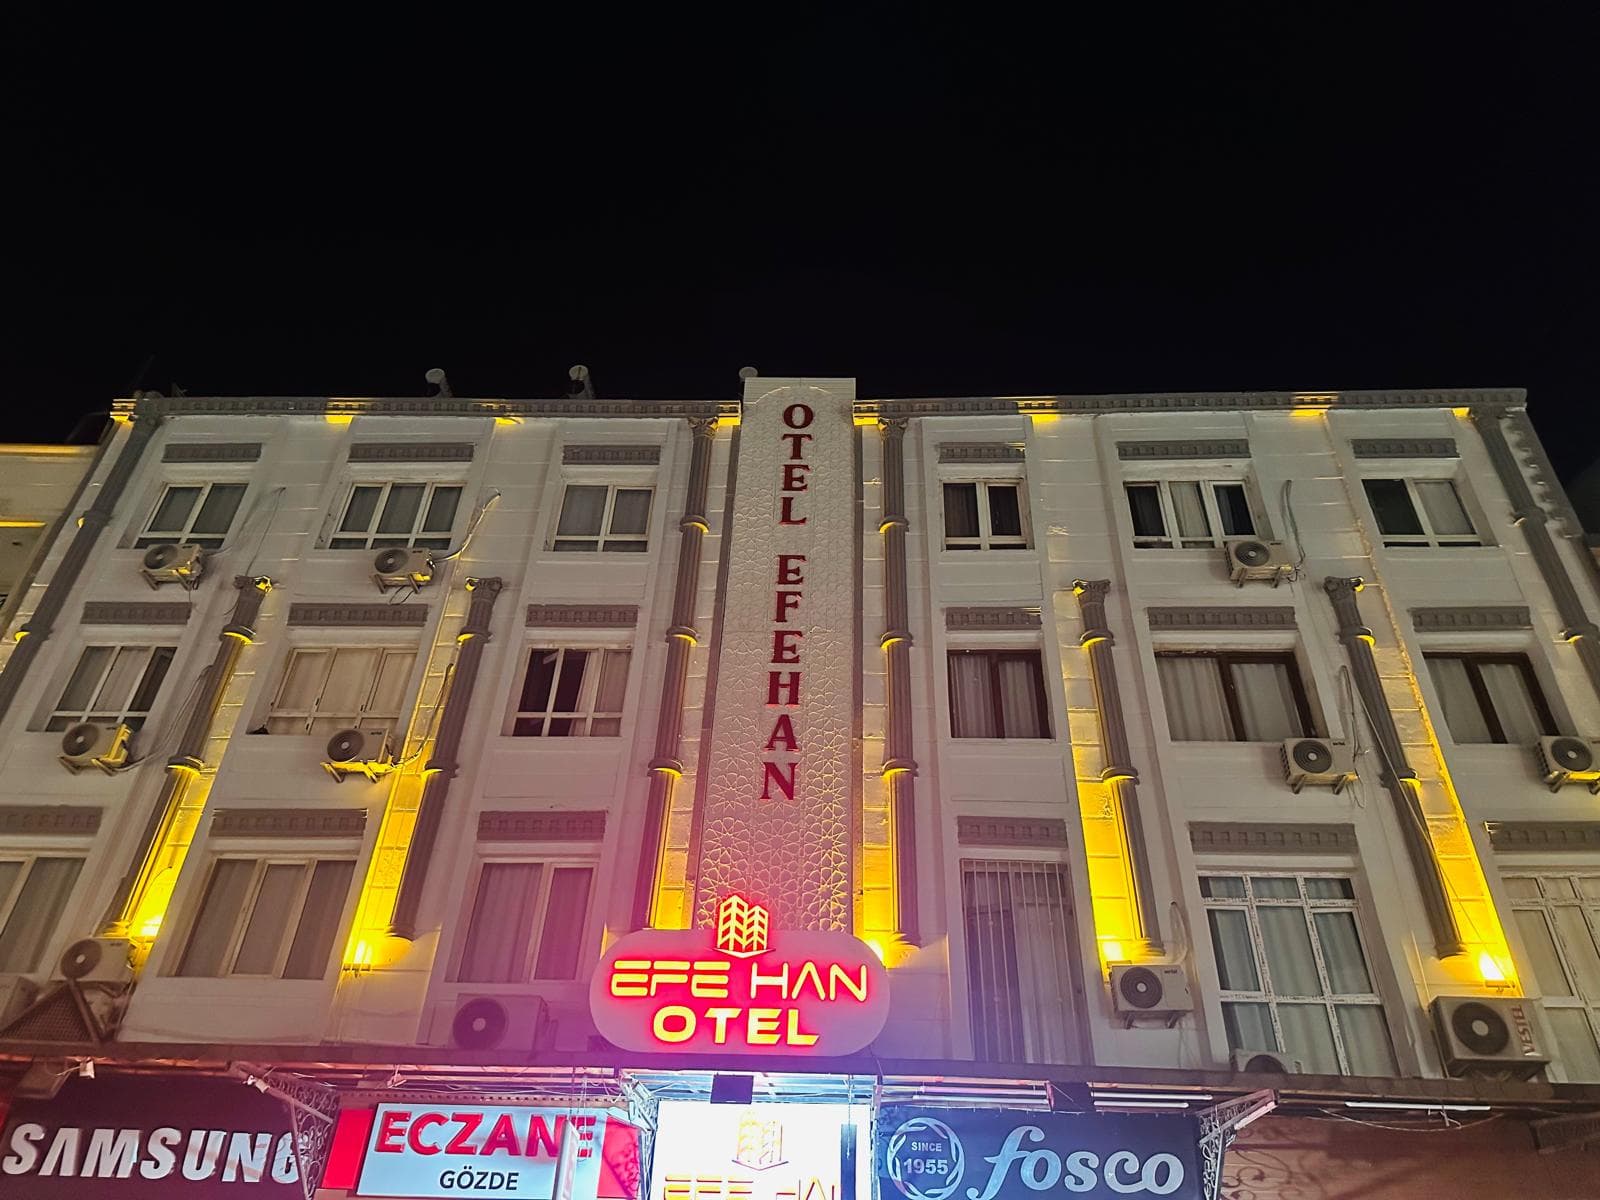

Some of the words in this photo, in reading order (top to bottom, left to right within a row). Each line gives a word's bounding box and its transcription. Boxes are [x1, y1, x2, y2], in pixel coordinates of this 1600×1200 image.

[778, 403, 815, 526] OTEL
[610, 960, 731, 998] EFE
[750, 961, 867, 1002] HAN
[653, 1005, 820, 1046] OTEL
[374, 1110, 597, 1158] ECZANE
[911, 1141, 942, 1152] SINCE
[440, 1166, 520, 1191] GÖZDE
[903, 1158, 949, 1175] 1955
[967, 1125, 1185, 1200] fosco
